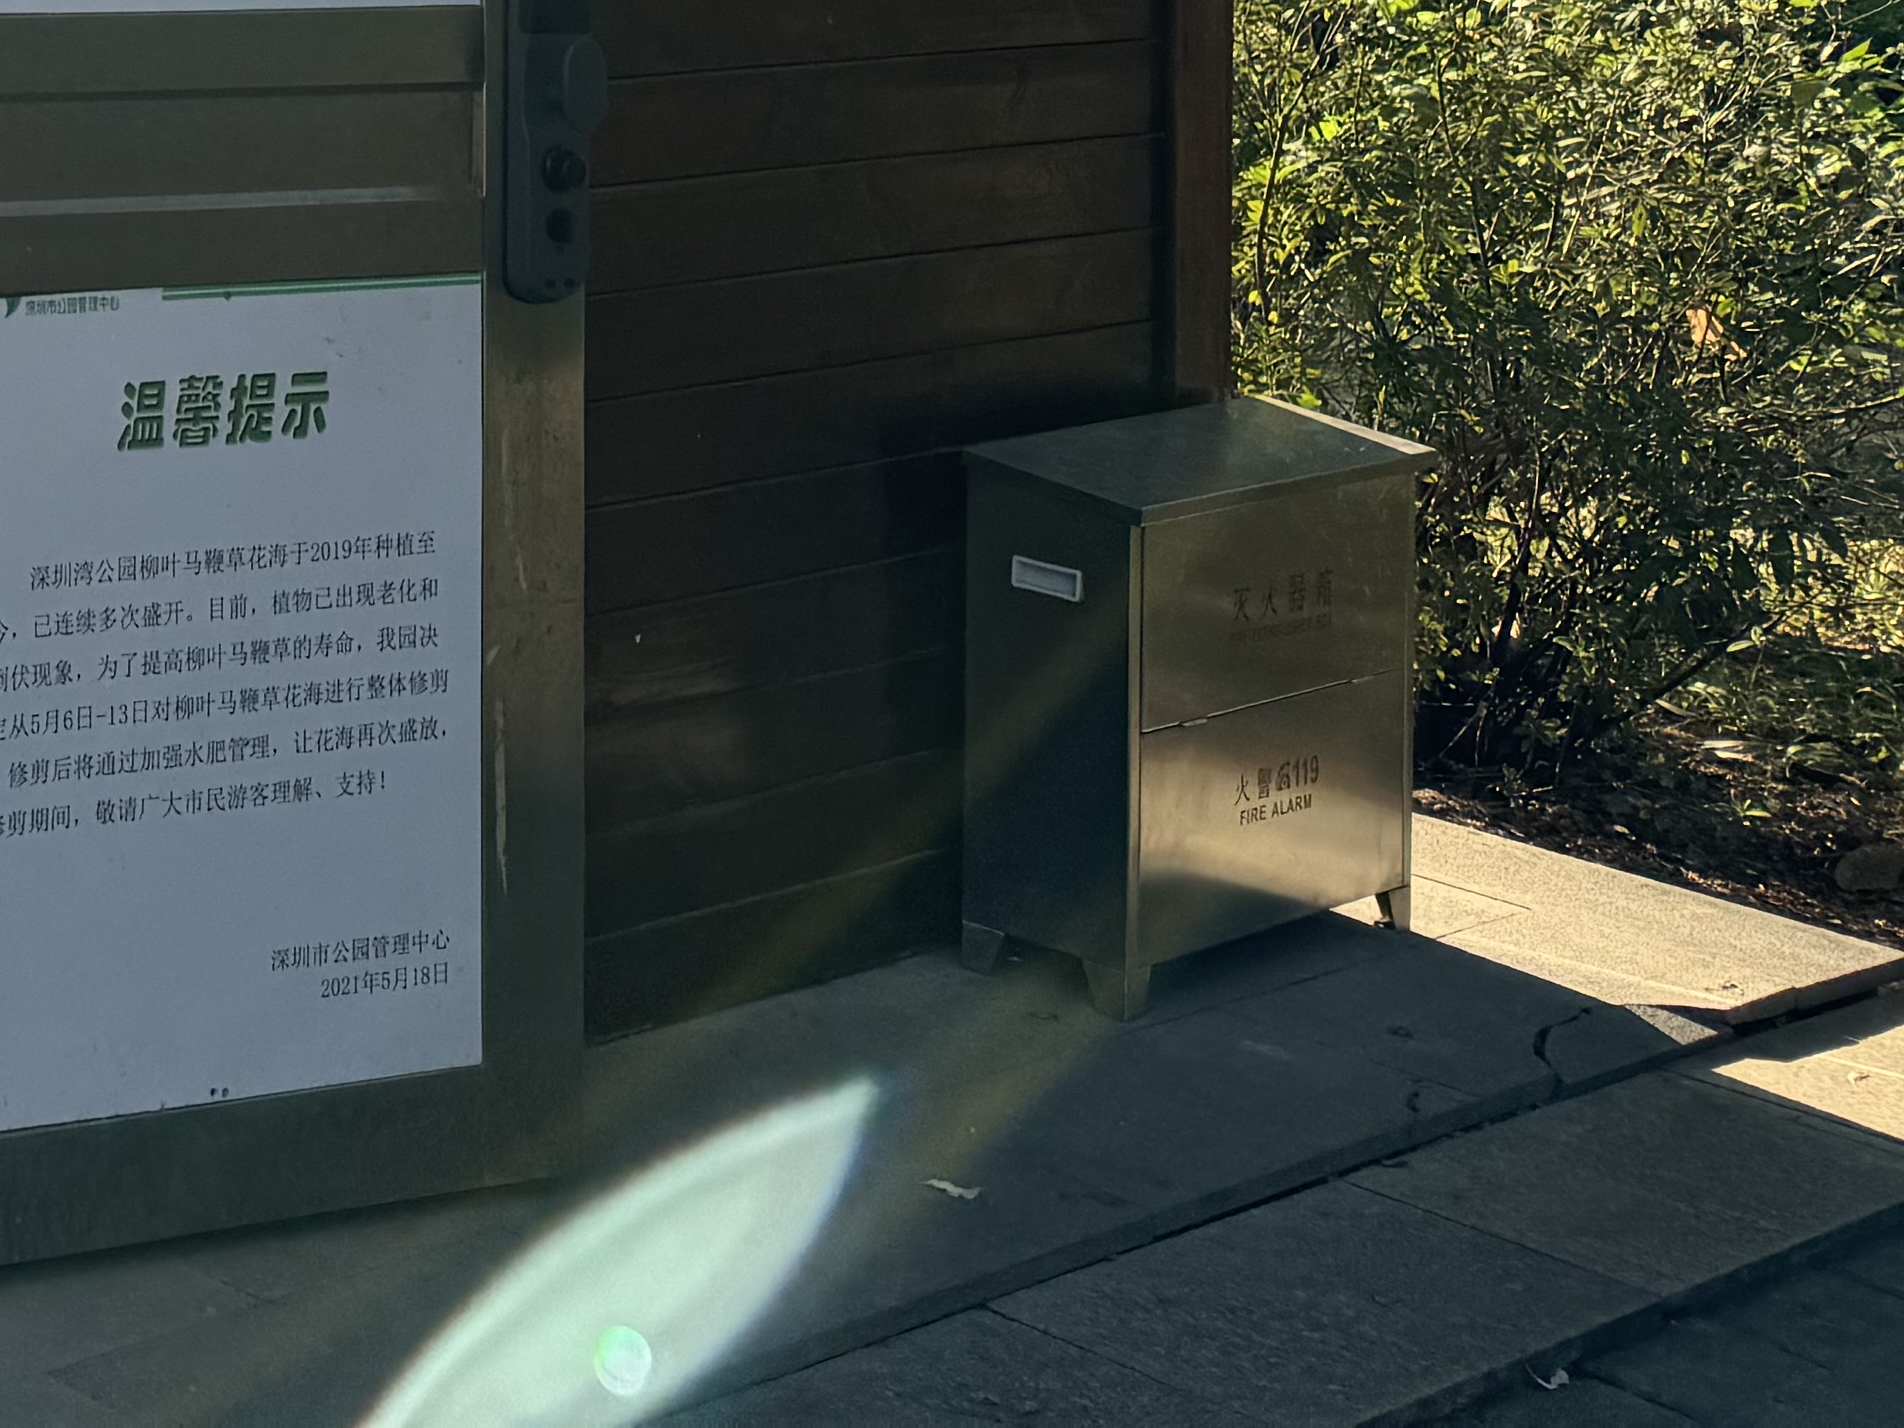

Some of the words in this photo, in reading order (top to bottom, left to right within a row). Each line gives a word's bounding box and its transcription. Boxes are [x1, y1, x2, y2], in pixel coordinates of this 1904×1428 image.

[117, 371, 330, 452] 温馨提示
[30, 530, 436, 591] 深圳湾公园柳叶马鞭草花海于2019年种植至
[1292, 753, 1321, 787] 119
[1239, 804, 1267, 826] FIRE
[1271, 792, 1314, 819] ALARM
[271, 929, 450, 972] 深圳市公园管理中心
[321, 962, 449, 999] 2021年5月18日
